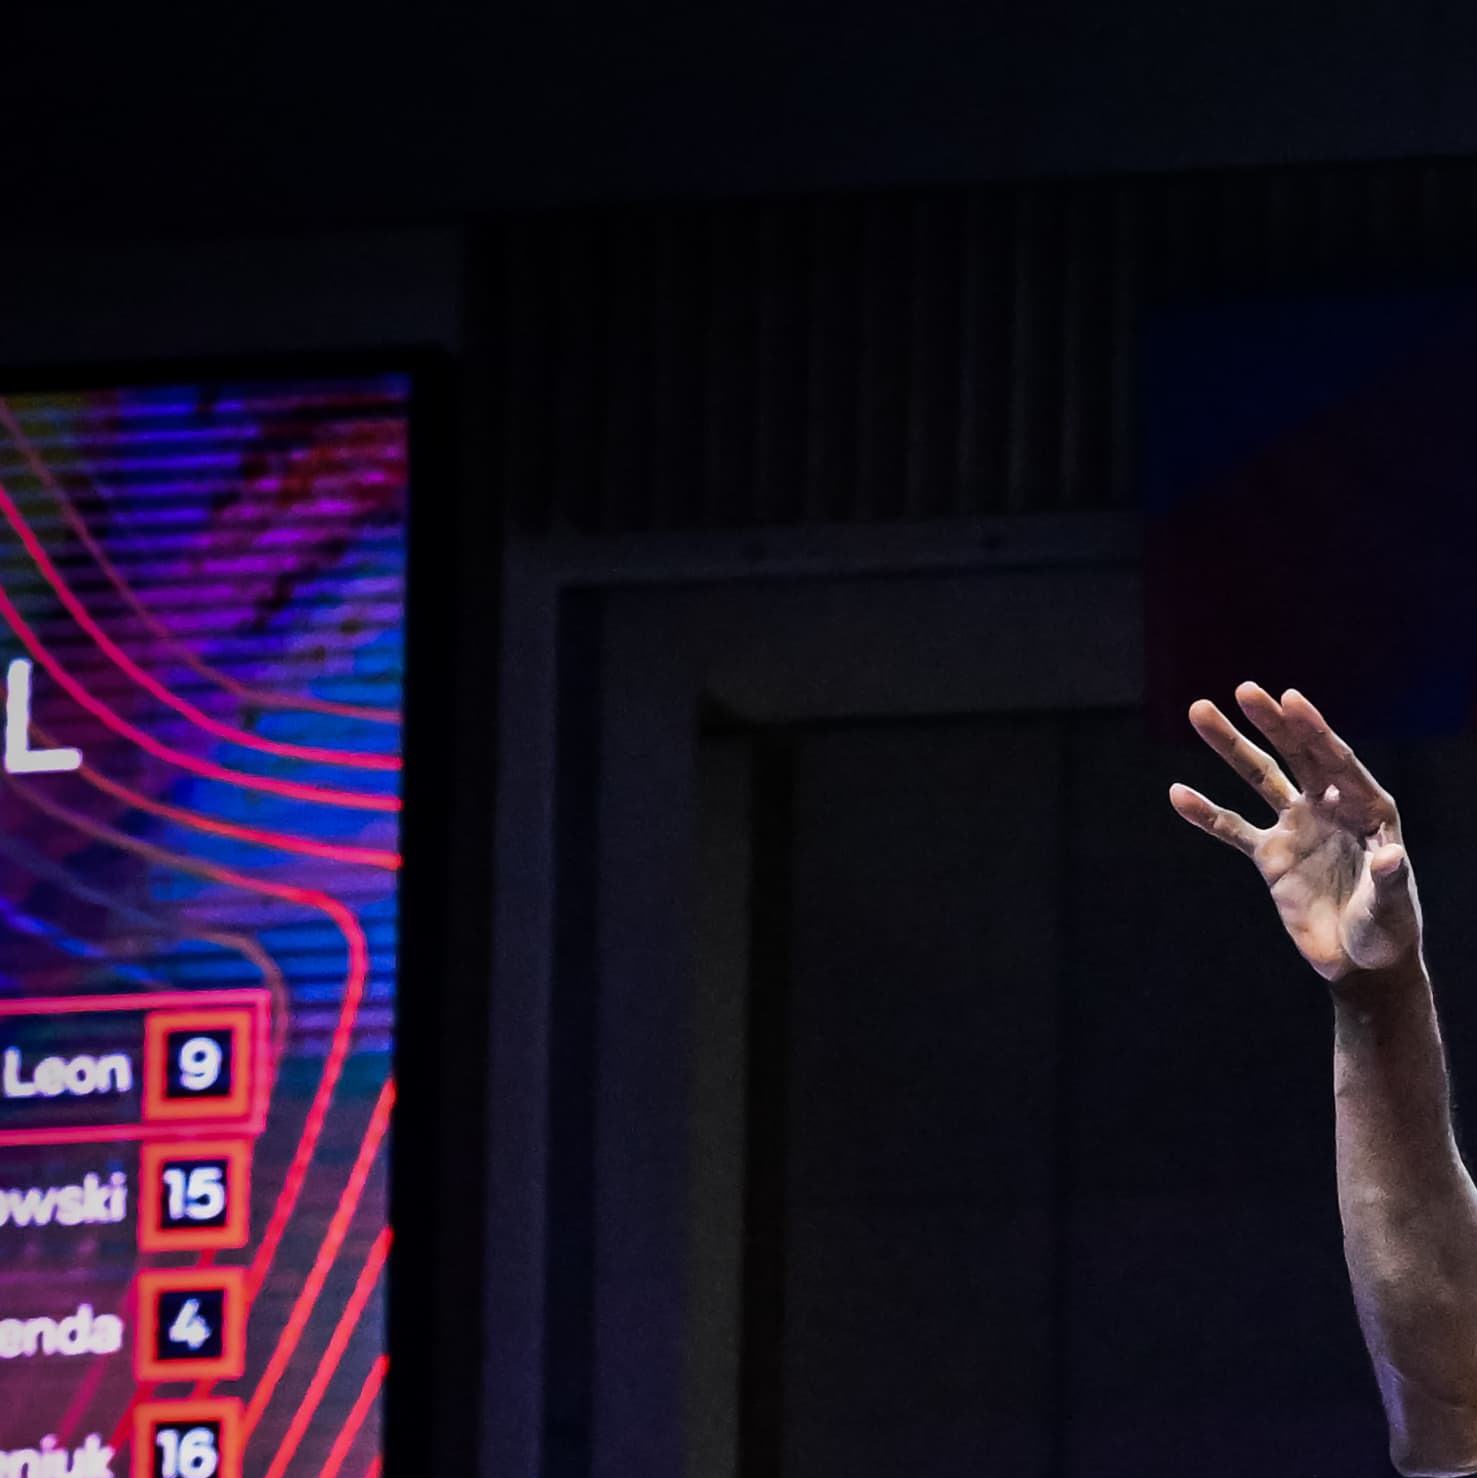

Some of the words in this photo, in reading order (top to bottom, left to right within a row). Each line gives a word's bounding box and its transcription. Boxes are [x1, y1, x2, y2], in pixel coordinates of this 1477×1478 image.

[5, 659, 82, 773] L
[3, 1046, 132, 1098] Leon
[178, 1036, 222, 1091] 9
[163, 1166, 225, 1220] 15
[168, 1298, 211, 1350] 4
